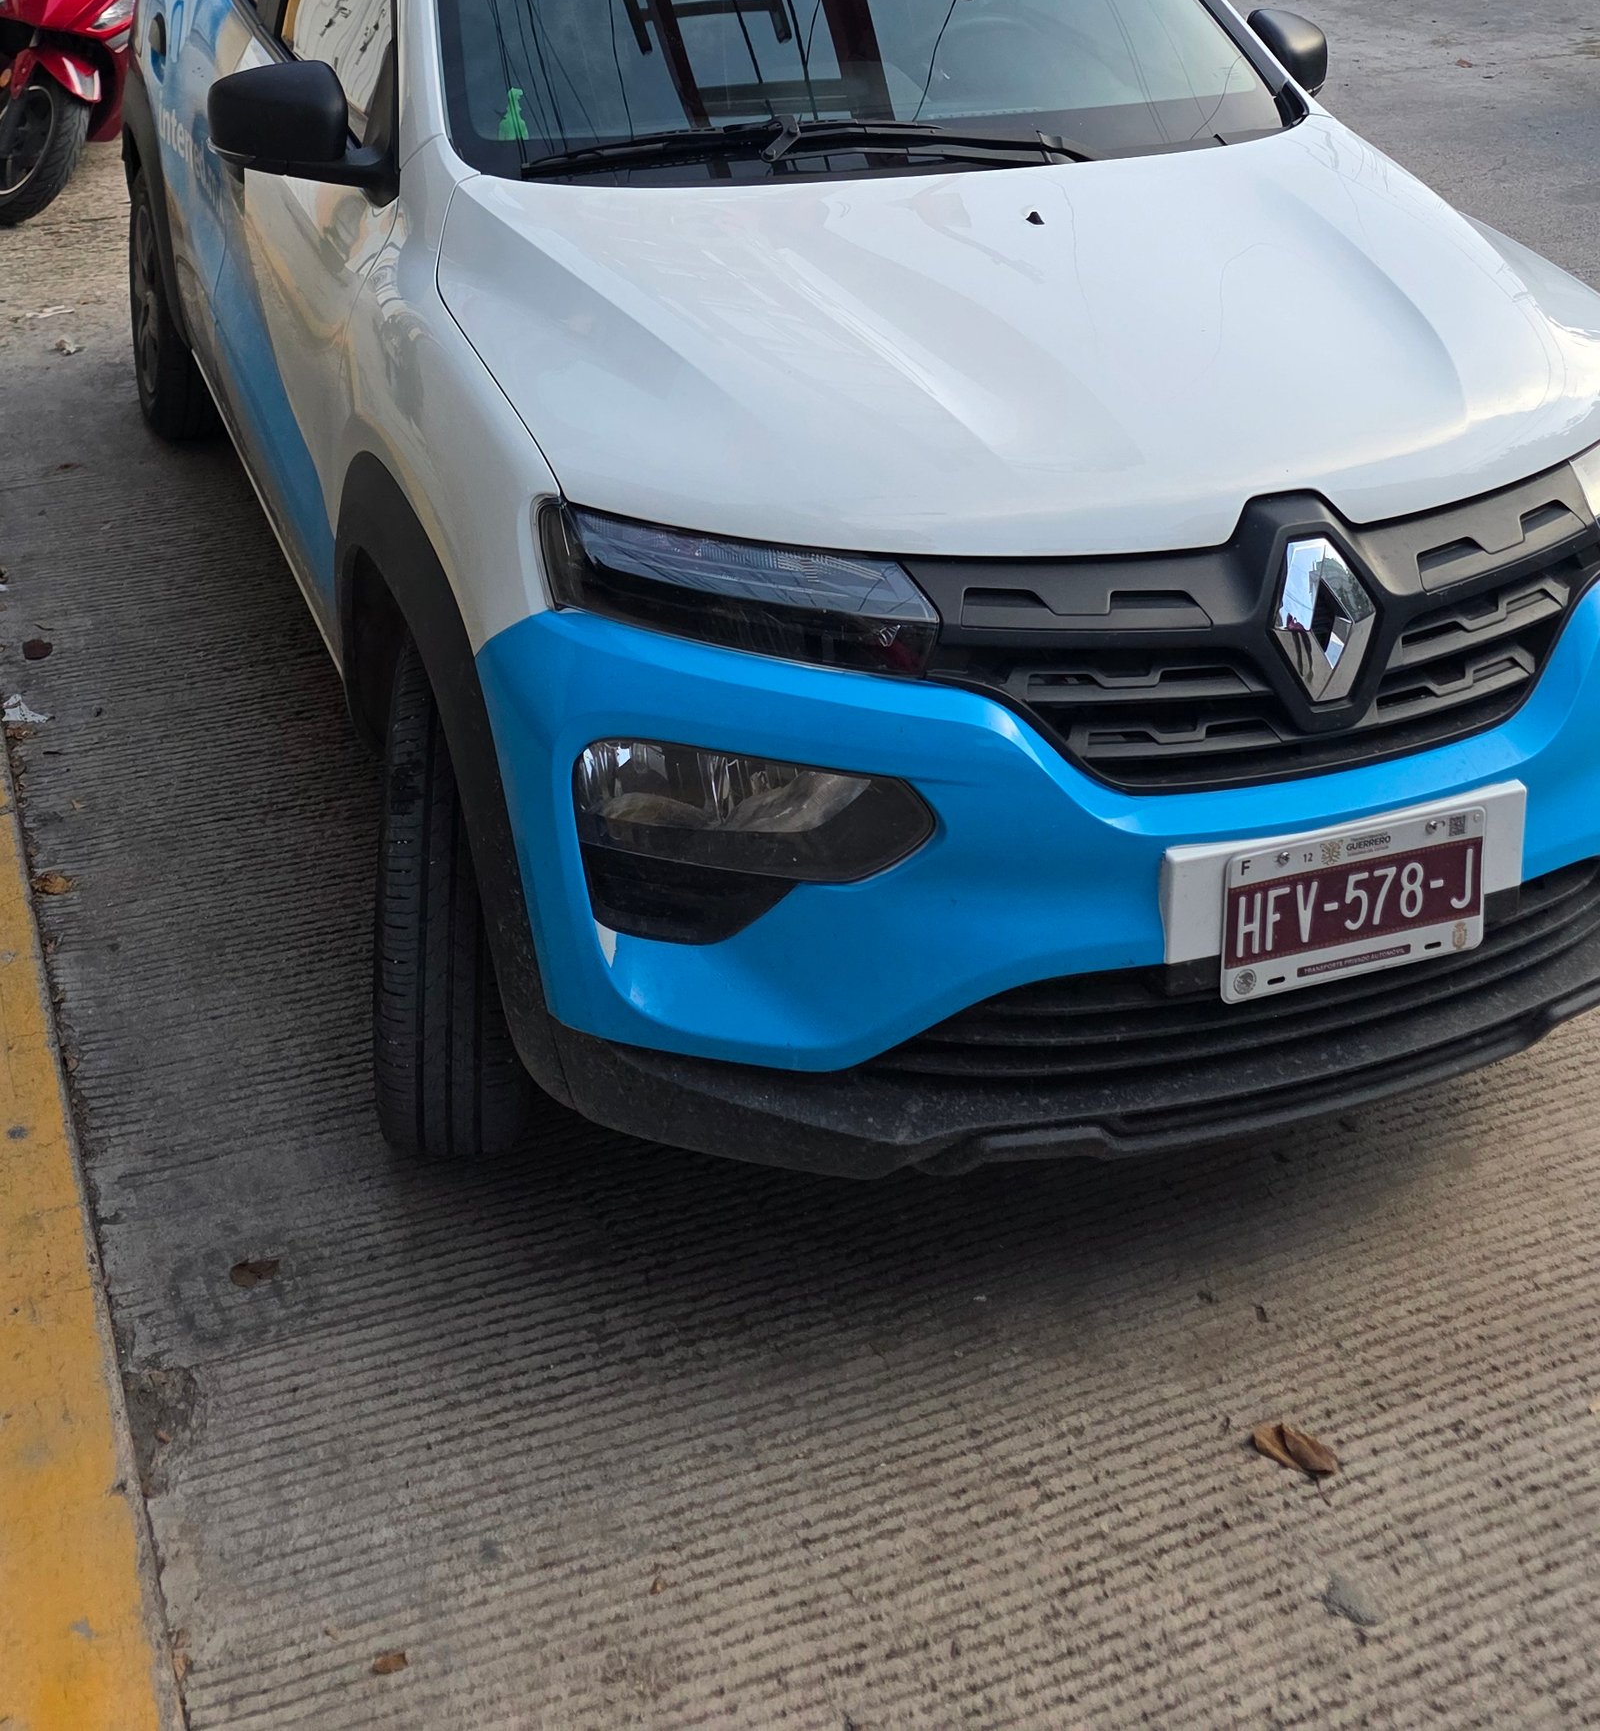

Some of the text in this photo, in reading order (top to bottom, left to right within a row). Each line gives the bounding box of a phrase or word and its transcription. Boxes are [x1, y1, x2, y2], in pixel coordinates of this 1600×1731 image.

[1346, 836, 1391, 851] GUERRERO
[1303, 852, 1314, 863] 12
[1240, 859, 1252, 875] F
[1237, 848, 1474, 958] HFV-578-J
